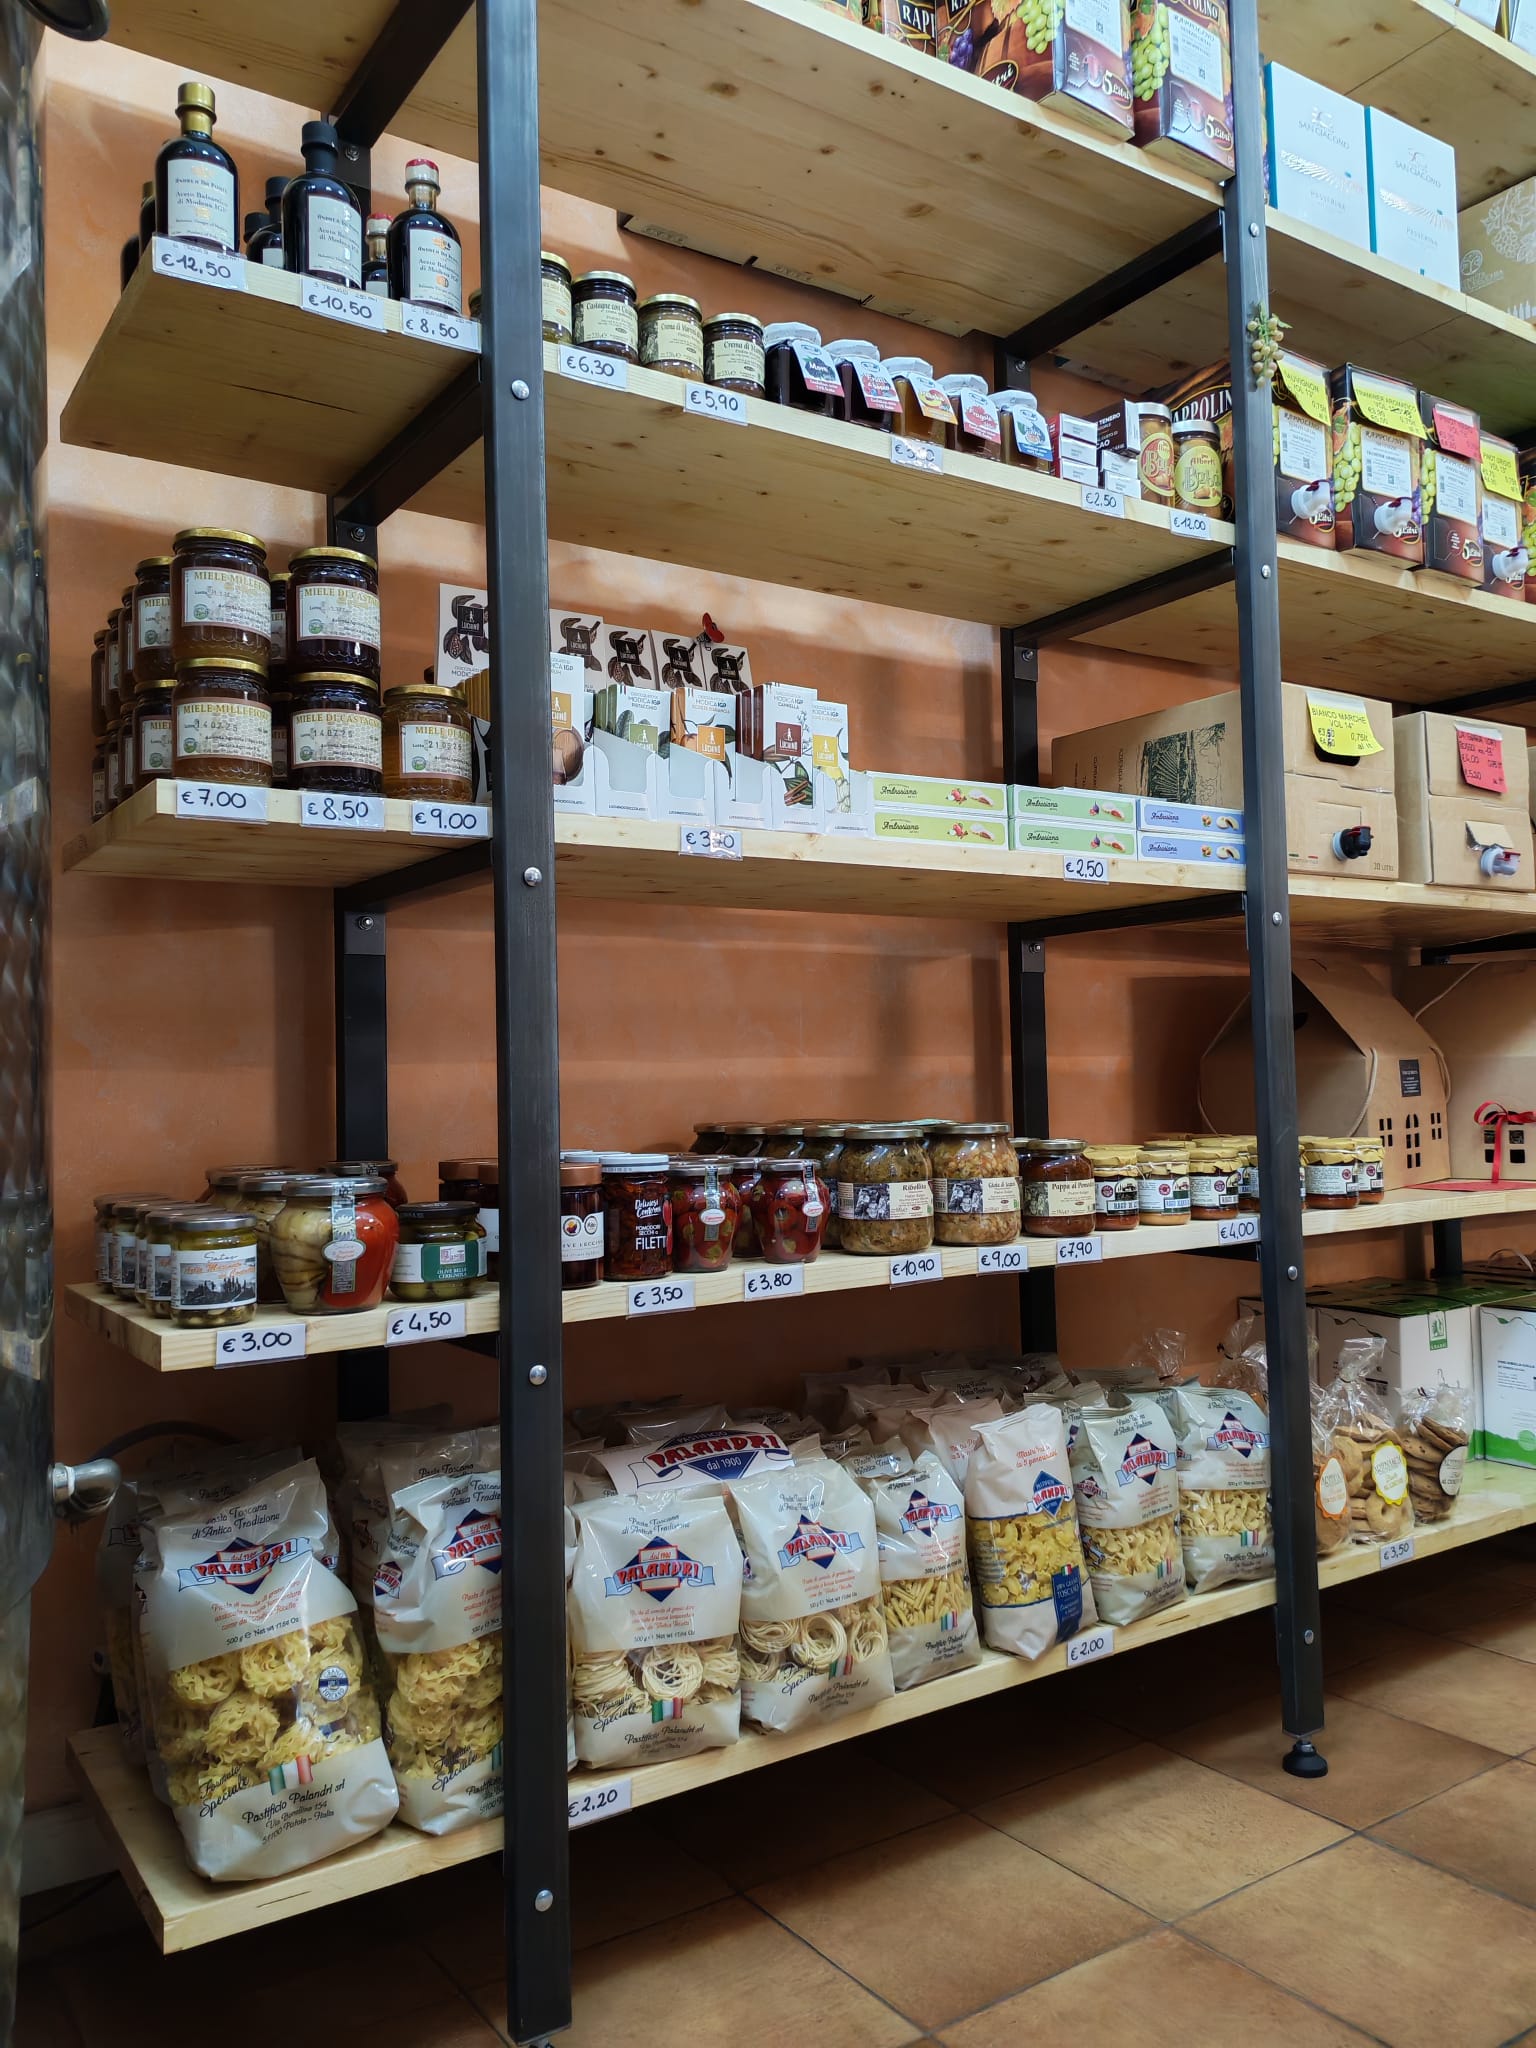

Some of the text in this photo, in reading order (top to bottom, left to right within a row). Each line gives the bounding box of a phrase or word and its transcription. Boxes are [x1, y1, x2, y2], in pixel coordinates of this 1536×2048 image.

[647, 1433, 782, 1468] PALANDRI
[194, 1540, 293, 1578] PALANDRI
[616, 1560, 700, 1585] PALANDRI
